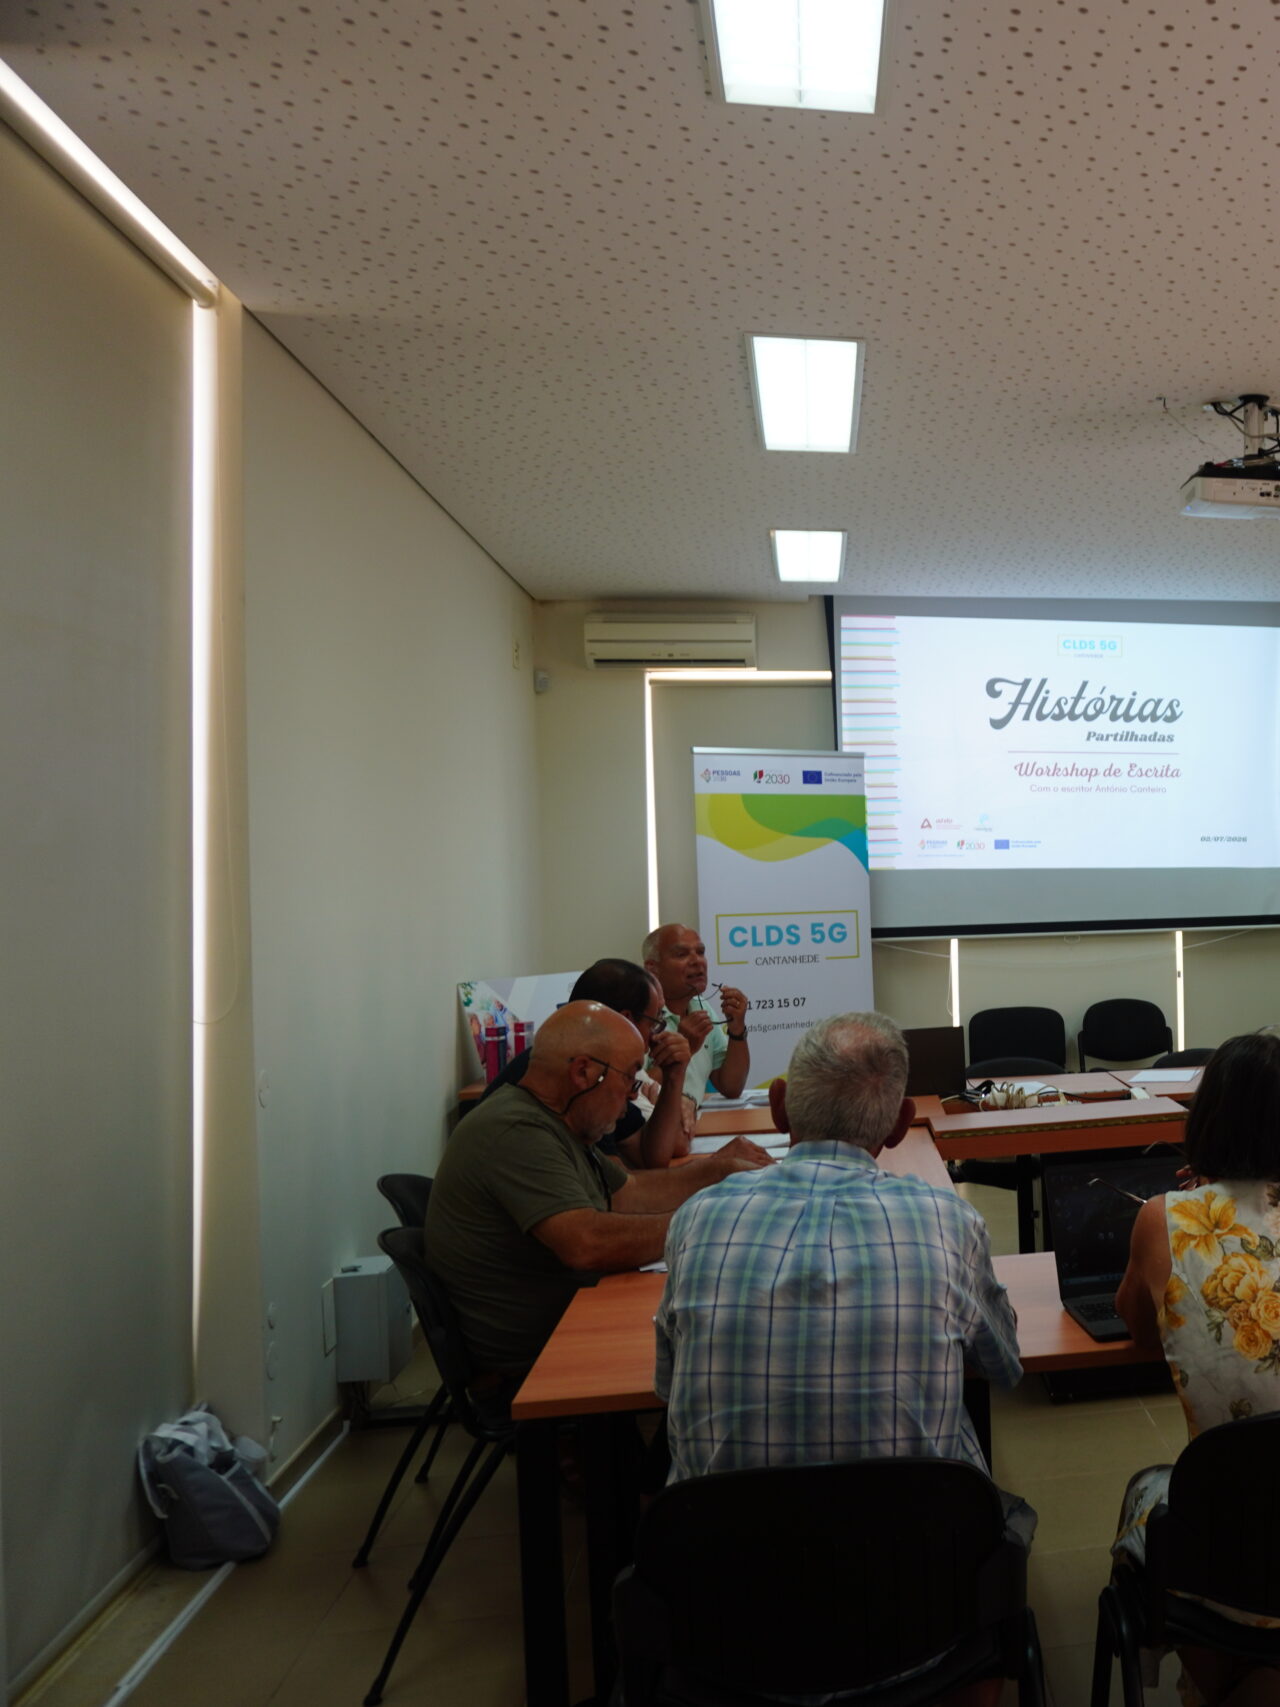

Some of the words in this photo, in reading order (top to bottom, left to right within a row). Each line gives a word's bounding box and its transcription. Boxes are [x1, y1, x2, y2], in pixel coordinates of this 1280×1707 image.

[1062, 639, 1096, 650] CLDS
[1100, 640, 1118, 651] 5G
[985, 677, 1183, 730] Histórias
[1085, 730, 1175, 743] Partilhadas
[712, 769, 741, 777] PESSOAS
[1013, 761, 1099, 783] Workshop
[1102, 763, 1122, 778] de
[1126, 762, 1181, 778] Escrita
[765, 773, 791, 785] 2030
[1029, 784, 1051, 793] Com
[1061, 784, 1092, 793] escritor
[1094, 784, 1128, 793] António
[728, 923, 801, 948] CLDS
[810, 922, 848, 944] 5G
[755, 954, 820, 967] CANTANHEDE
[755, 999, 774, 1010] 723
[777, 998, 790, 1009] 15
[793, 997, 806, 1007] 07
